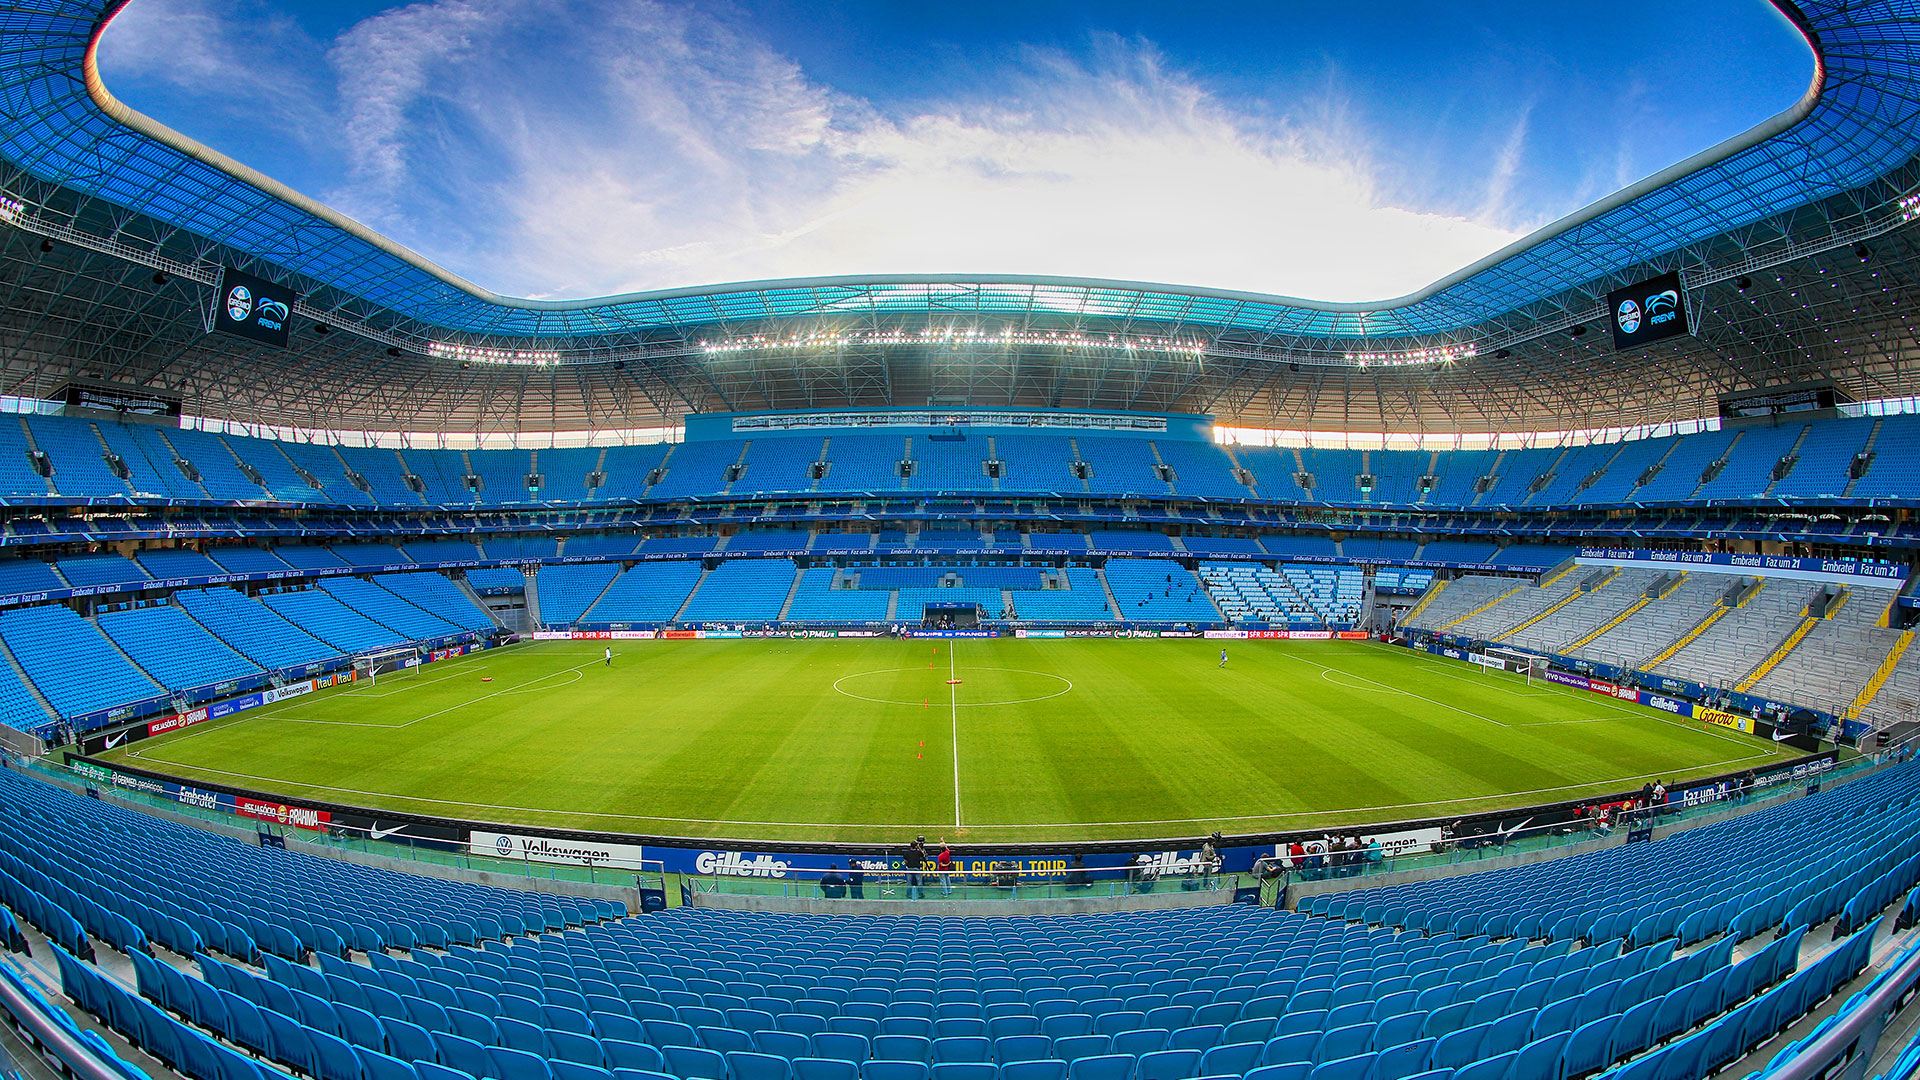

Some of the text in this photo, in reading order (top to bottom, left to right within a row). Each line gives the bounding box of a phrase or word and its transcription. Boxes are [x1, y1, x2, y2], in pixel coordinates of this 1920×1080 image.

[258, 317, 281, 331] ARENA
[1651, 311, 1675, 325] ARENA
[1581, 549, 1604, 558] Embratel
[1607, 549, 1617, 558] Faz
[1627, 551, 1635, 559] 21
[1650, 551, 1678, 561] Embratel
[1681, 552, 1692, 561] Faz
[1704, 554, 1712, 563] 21
[1731, 555, 1801, 569] Embratel Faz um 21
[1822, 560, 1898, 577] Embratel Faz um 21
[0, 597, 18, 606] mbratel
[317, 676, 333, 689] Itaú
[337, 673, 352, 684] Itaú
[277, 685, 309, 698] Volkswagen
[1650, 695, 1679, 713] Gillette
[186, 708, 208, 725] BRAHMA
[1699, 707, 1735, 726] Garoto
[179, 786, 218, 810] Embratel
[1683, 790, 1699, 807] Faz
[1700, 788, 1715, 803] um
[522, 839, 610, 864] Volkswagen
[696, 851, 788, 878] Gillette
[1029, 860, 1067, 877] TOUR
